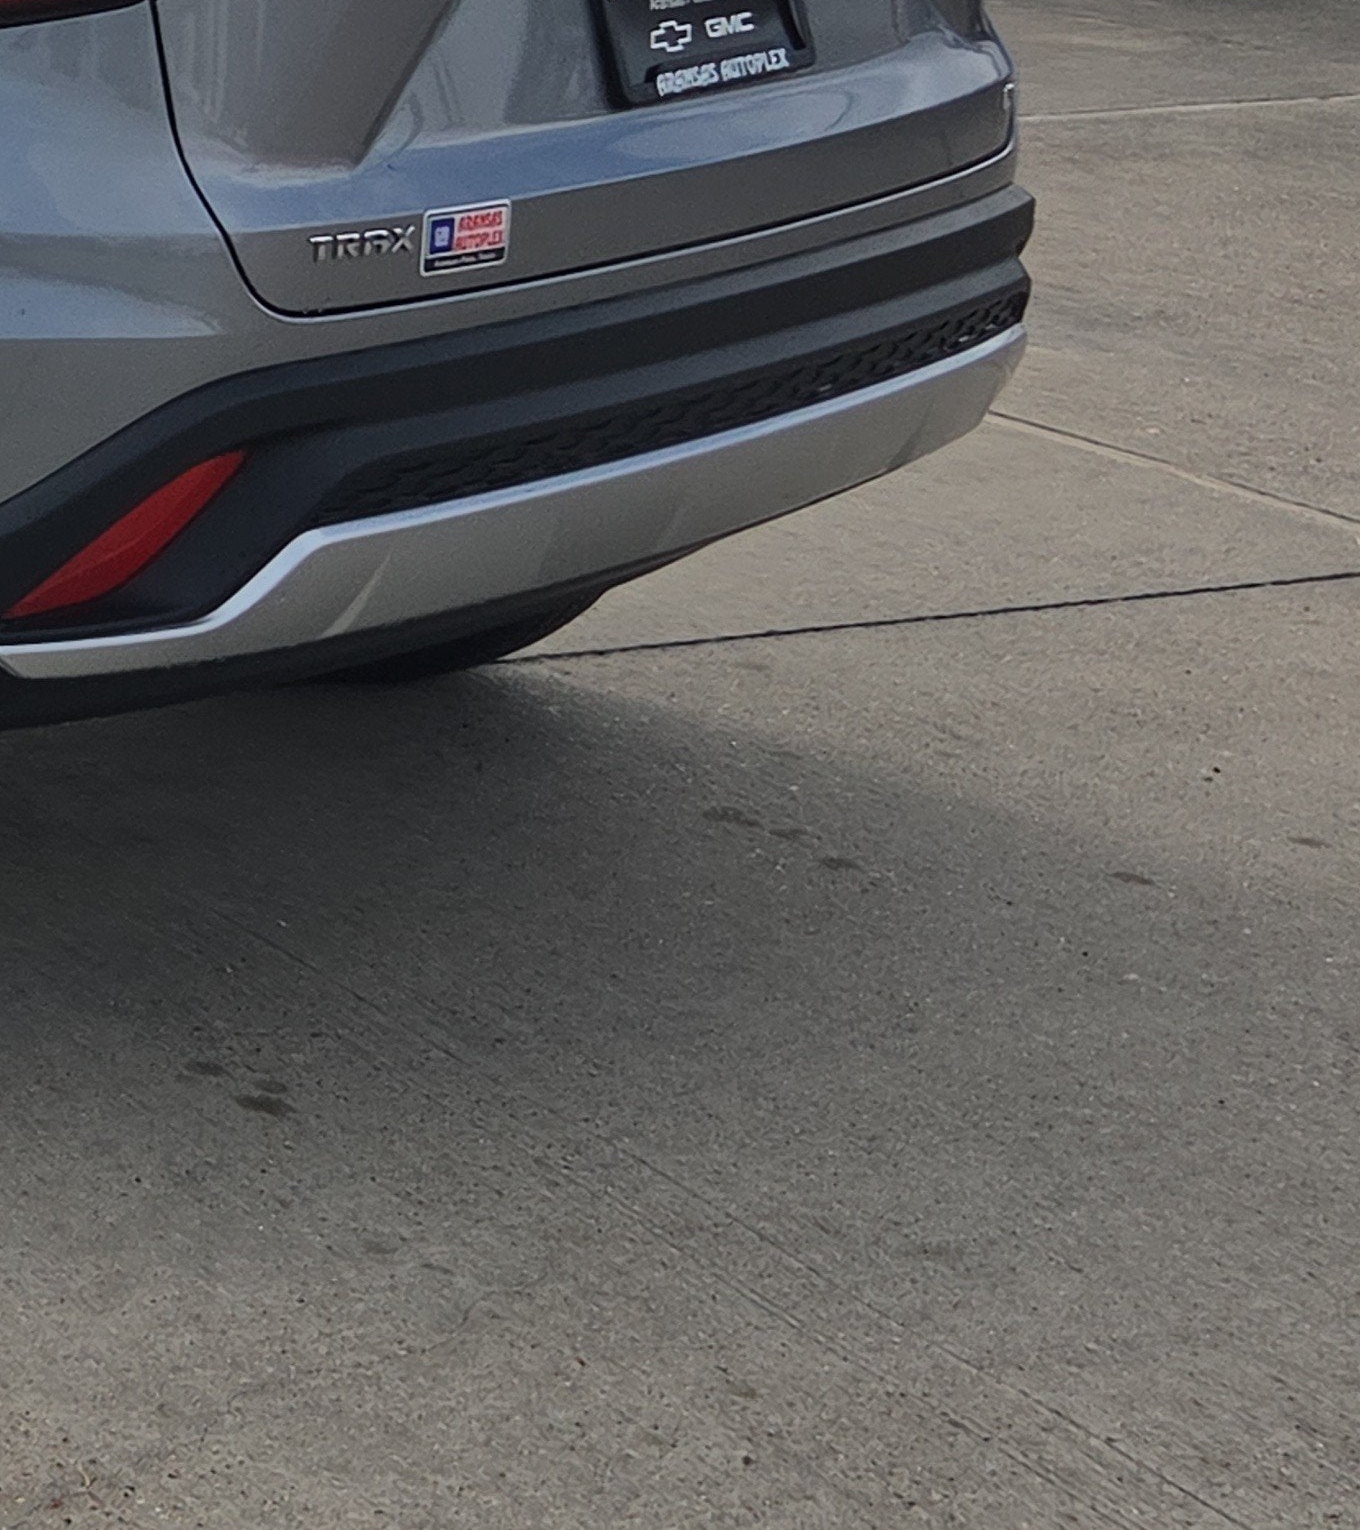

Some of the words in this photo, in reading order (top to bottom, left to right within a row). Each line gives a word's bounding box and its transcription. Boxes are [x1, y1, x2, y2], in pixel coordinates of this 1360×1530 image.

[705, 12, 755, 38] GMC
[656, 62, 719, 97] ARANSAS
[720, 48, 790, 82] AUTOPLEX
[308, 225, 416, 263] TRAX
